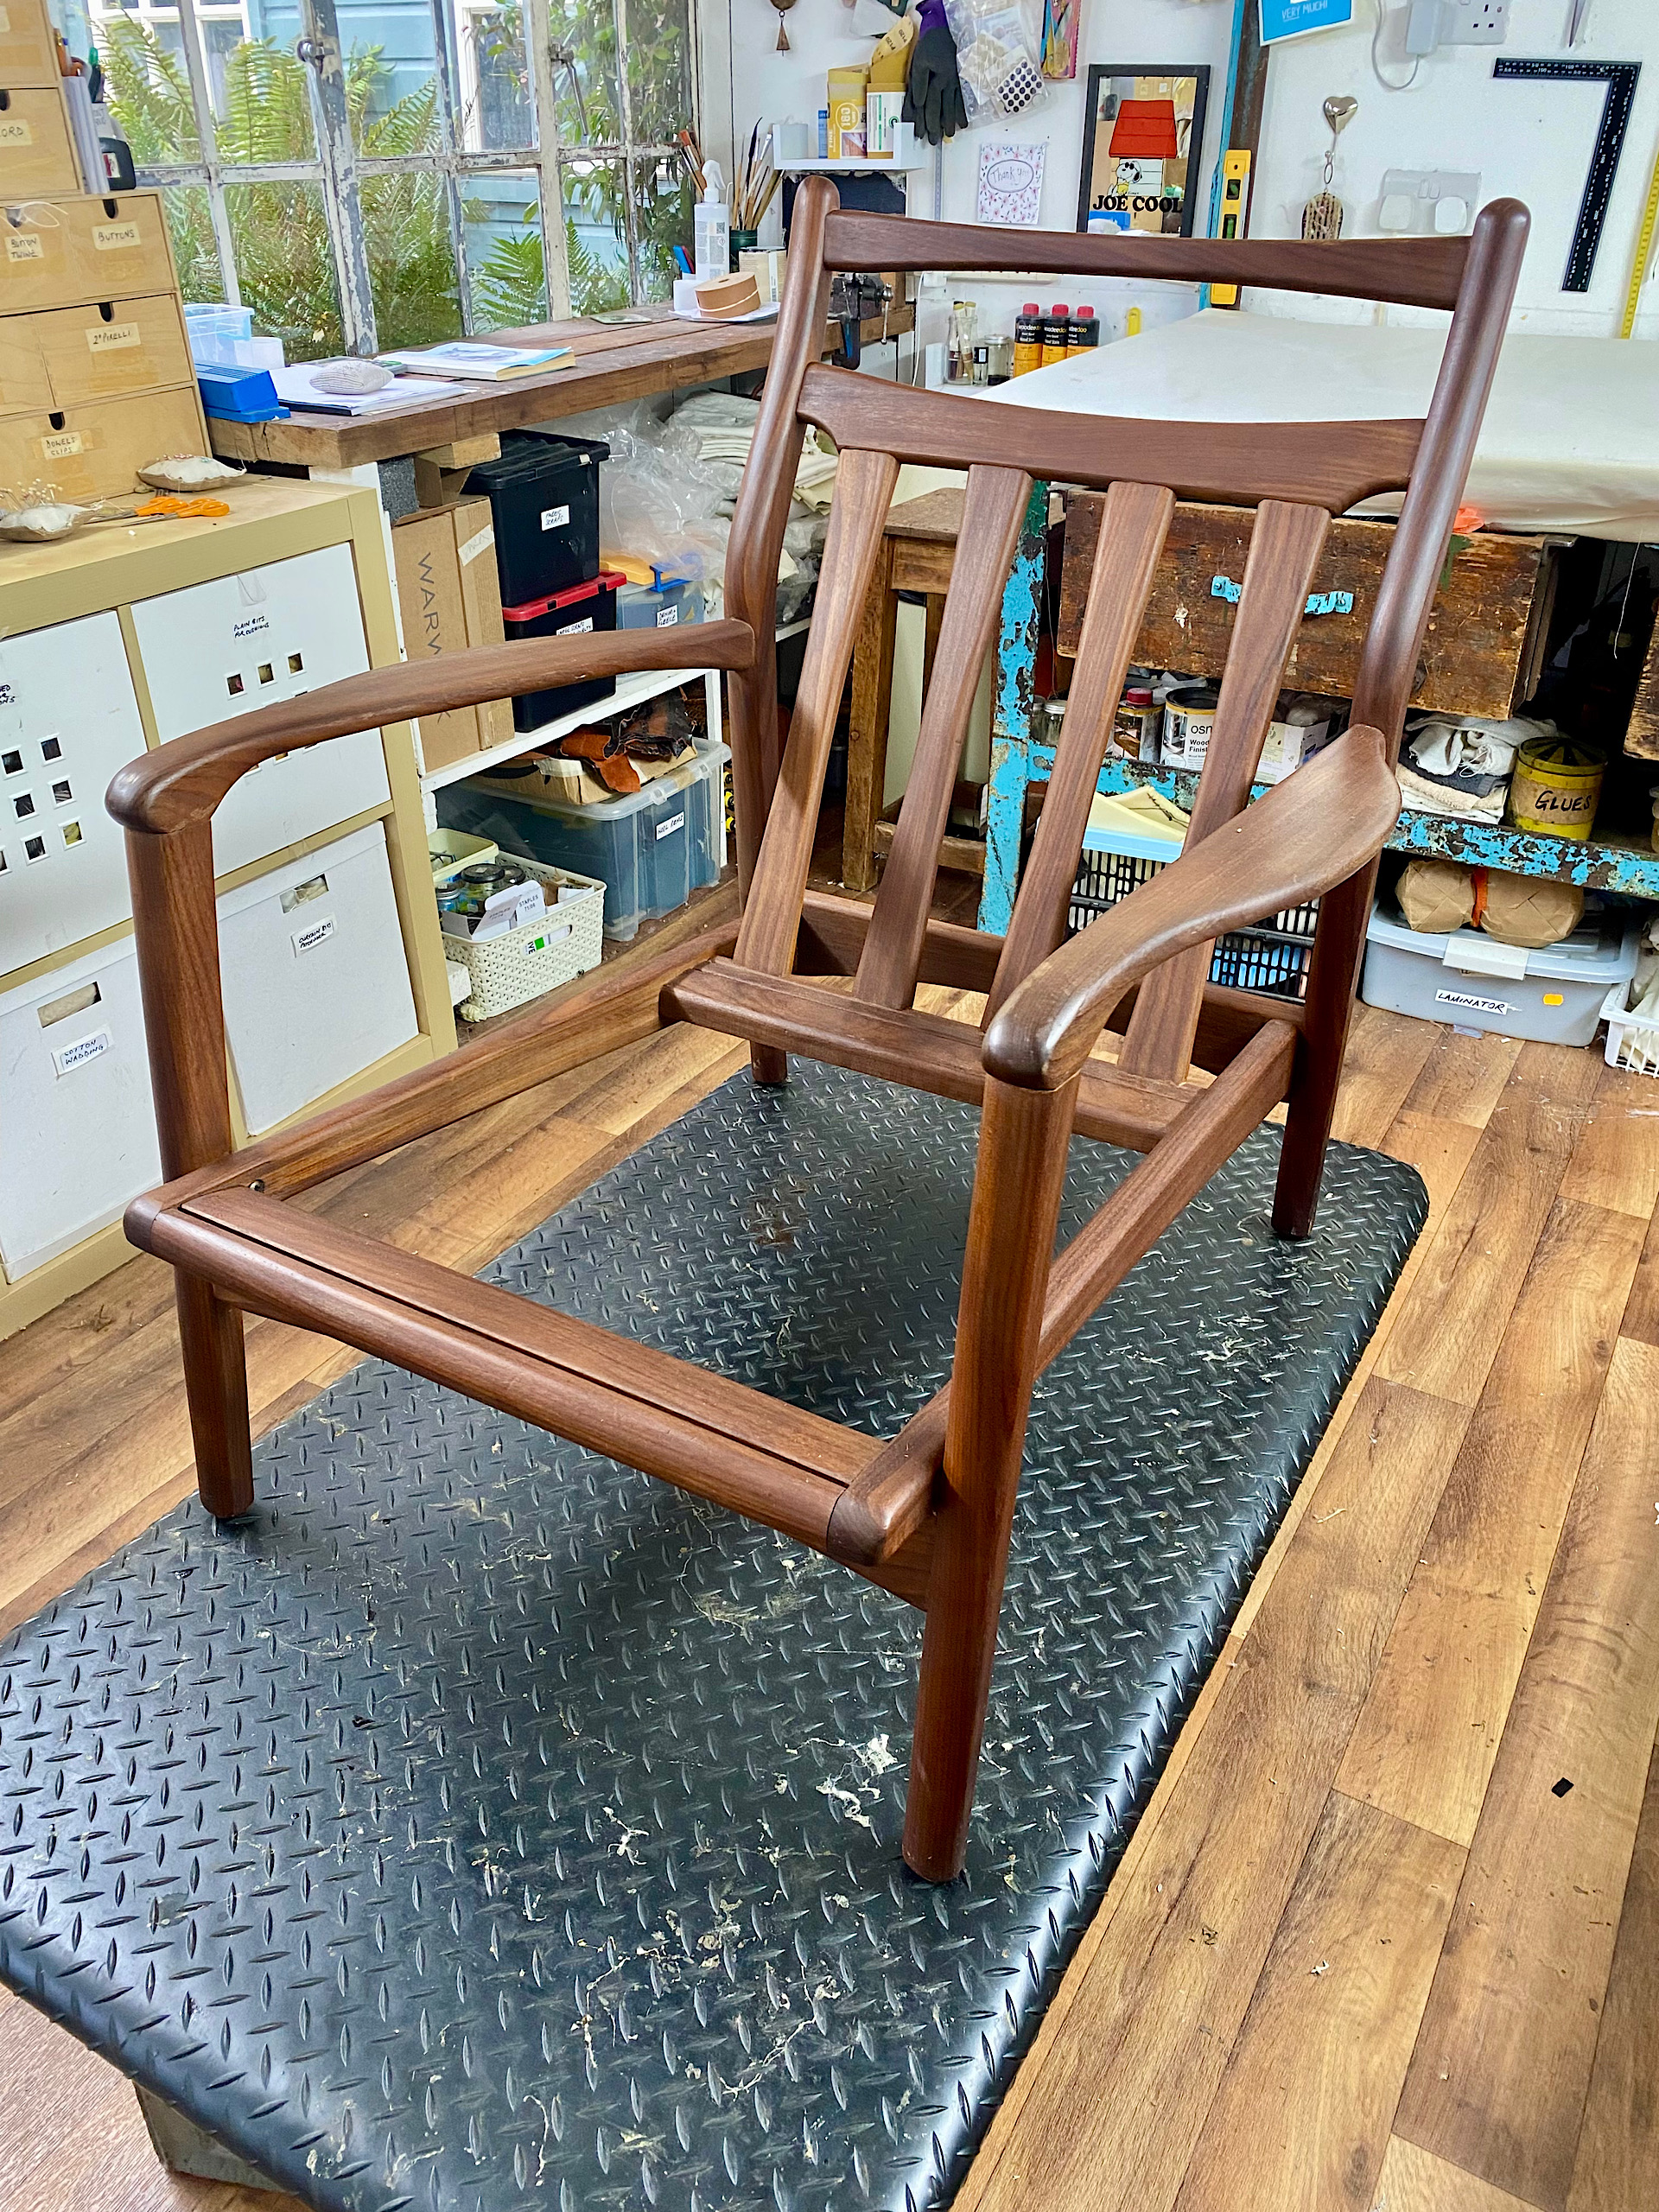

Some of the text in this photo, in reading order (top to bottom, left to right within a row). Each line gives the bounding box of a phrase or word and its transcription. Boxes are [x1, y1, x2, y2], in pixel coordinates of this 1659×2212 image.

[1281, 5, 1300, 20] VERY
[886, 36, 896, 50] P120
[899, 29, 907, 43] P120
[841, 107, 851, 127] 180
[0, 126, 23, 137] ORD
[1092, 195, 1183, 213] JOE COOL
[98, 229, 136, 243] BUTTONS
[0, 683, 11, 692] ED
[1191, 725, 1213, 734] osm
[1535, 790, 1592, 812] GLUES
[518, 893, 539, 908] STAPLES
[1438, 992, 1505, 1014] LAMINATOR
[64, 1039, 97, 1056] COTTON
[65, 1044, 104, 1065] WADDING
